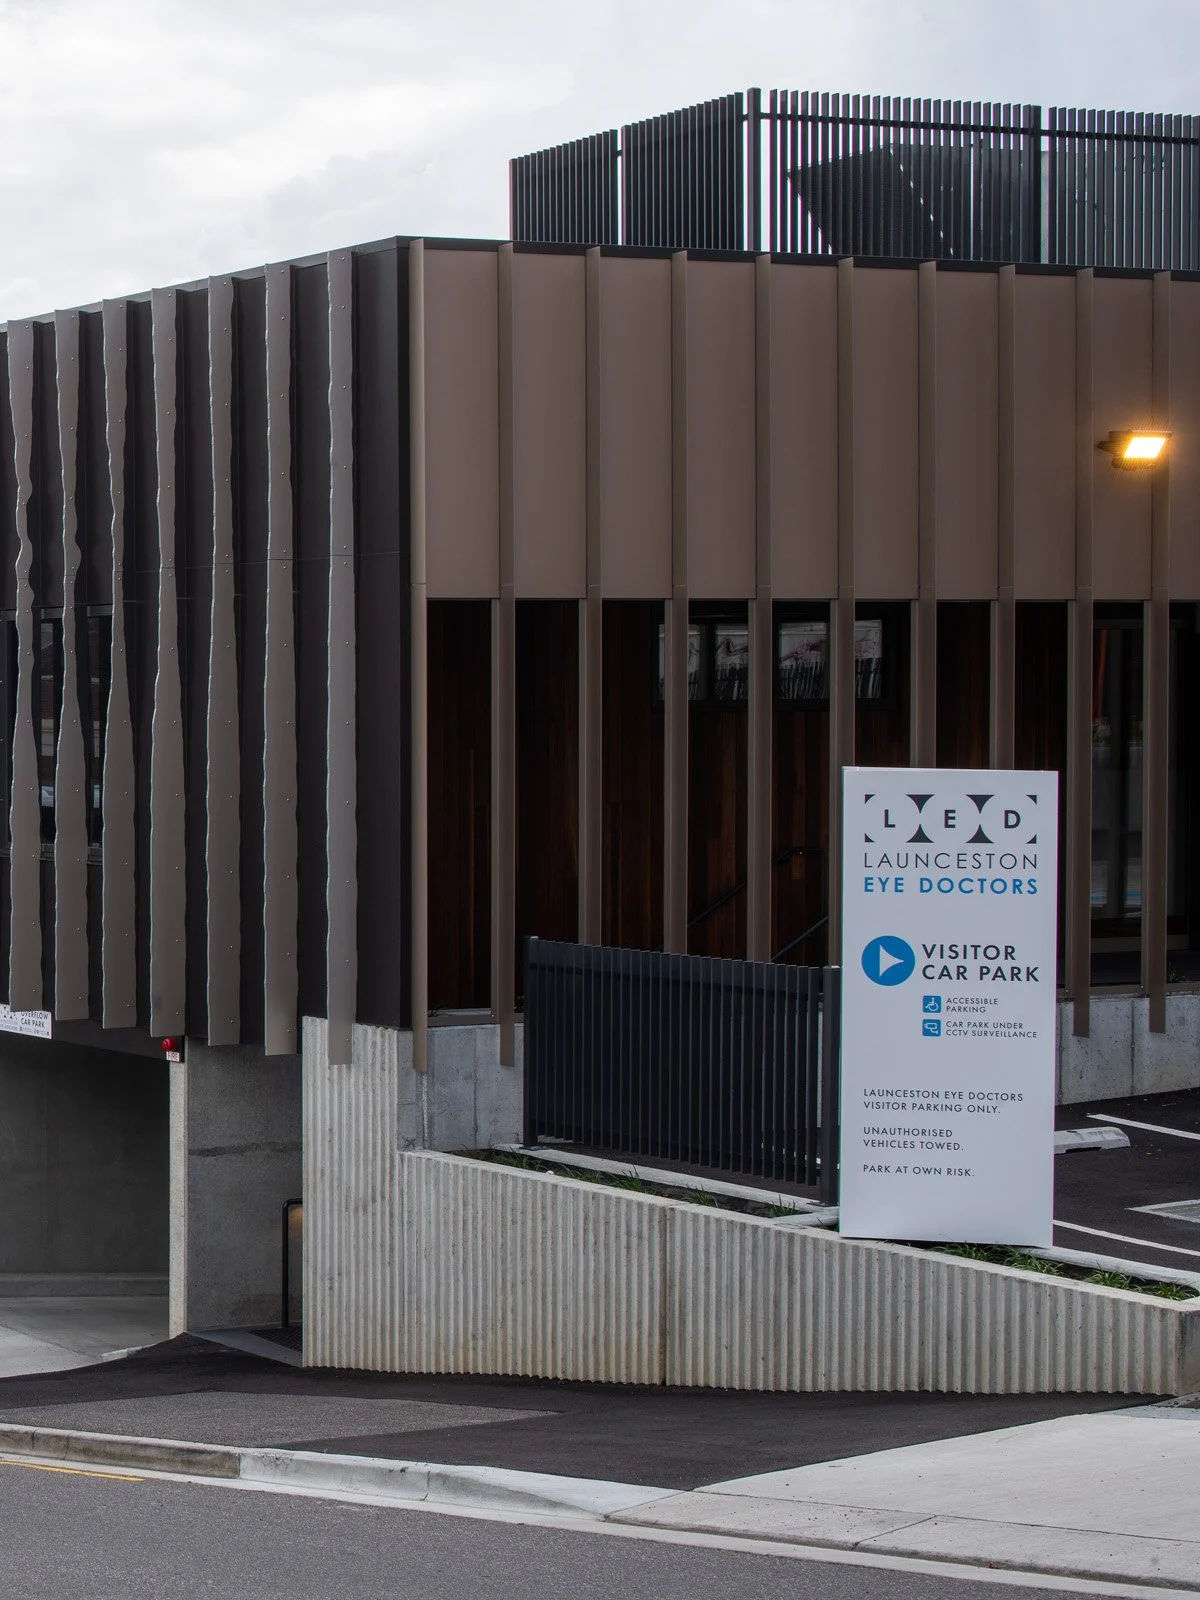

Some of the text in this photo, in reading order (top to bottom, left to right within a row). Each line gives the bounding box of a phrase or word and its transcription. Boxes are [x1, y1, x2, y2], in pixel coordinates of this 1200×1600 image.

[864, 852, 1037, 870] LAUNCESTON
[864, 877, 1038, 895] EYE DOCTORS
[922, 944, 1016, 961] VISITOR
[922, 965, 1040, 982] CAR PARK
[946, 997, 998, 1005] ACCESSIBLE
[967, 1021, 989, 1029] PARK
[993, 1022, 1023, 1030] UNDER
[971, 1030, 1038, 1039] SURVEILLANCE
[863, 1089, 1024, 1101] LAUNCESTON EYE DOCTORS
[863, 1101, 1001, 1114] VISITOR PARKING ONLY.
[863, 1126, 953, 1138] UNAUTHORISED
[863, 1139, 964, 1151] VEHICLES TOWED.
[863, 1164, 975, 1177] PARK AT OWN RISK.
